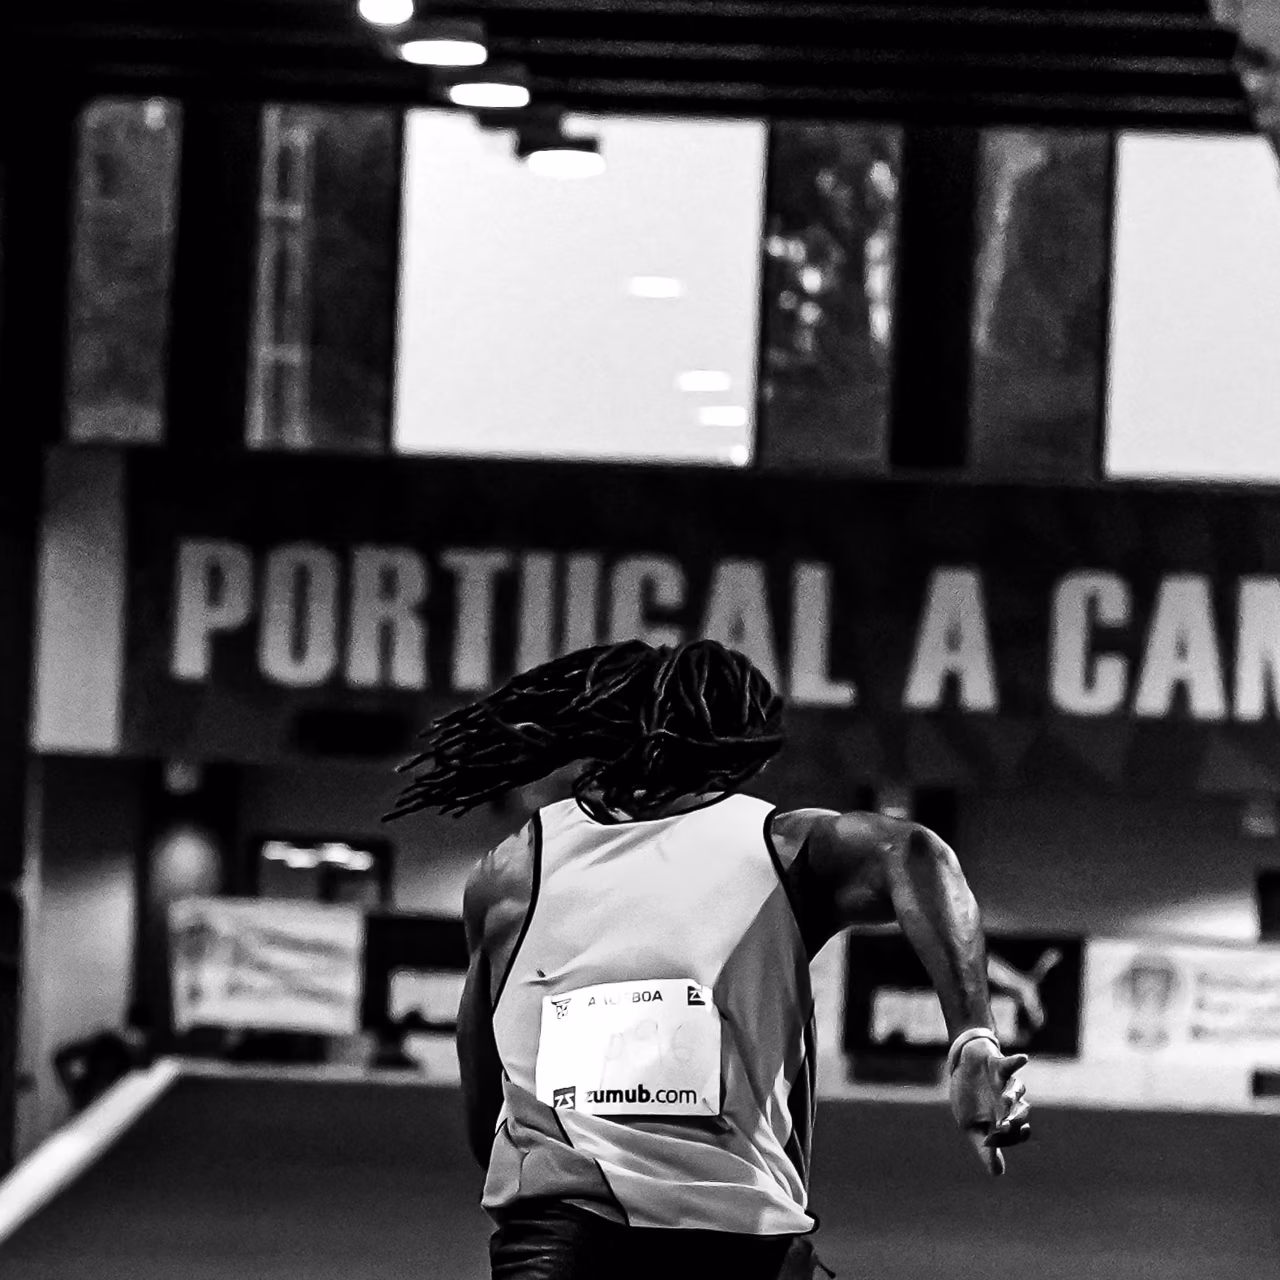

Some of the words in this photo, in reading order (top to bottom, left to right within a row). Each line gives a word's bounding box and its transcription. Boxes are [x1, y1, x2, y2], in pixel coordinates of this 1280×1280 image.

[171, 539, 857, 706] PORTUGAL
[903, 564, 997, 711] A
[586, 1084, 698, 1105] zumub.com
